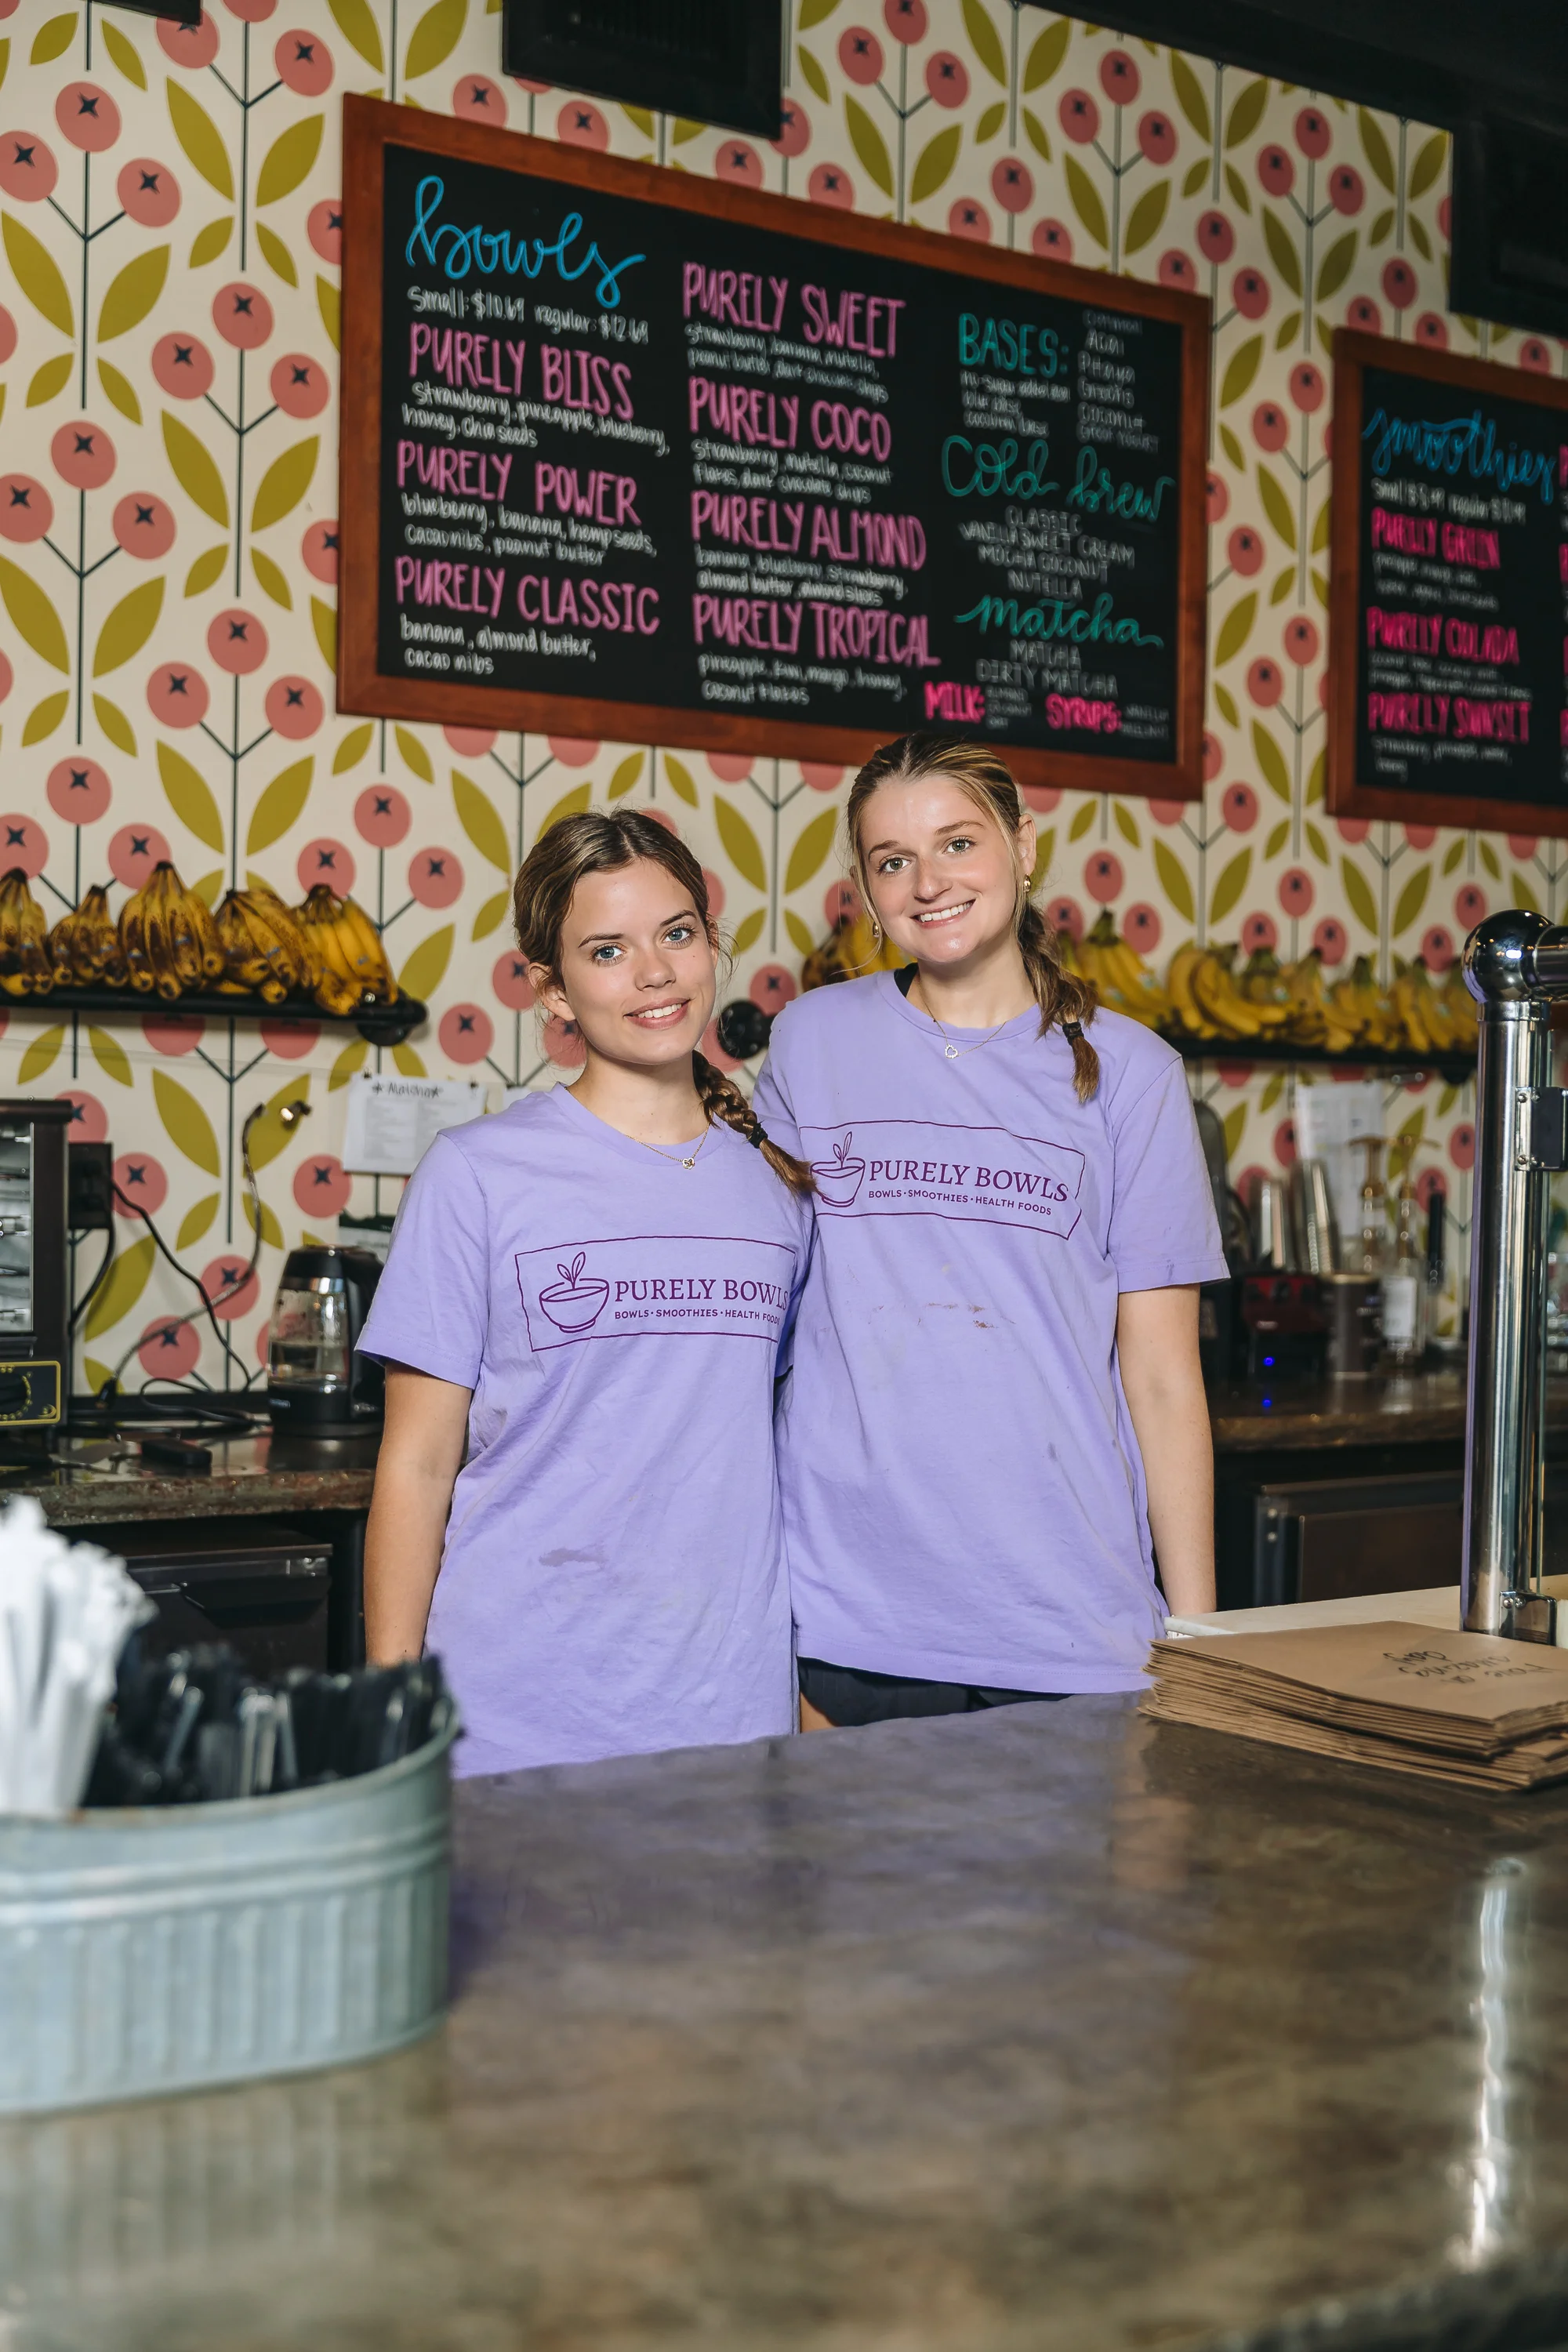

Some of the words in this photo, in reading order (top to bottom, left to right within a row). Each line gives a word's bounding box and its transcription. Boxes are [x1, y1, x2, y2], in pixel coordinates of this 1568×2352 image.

[406, 175, 646, 308] bowls
[683, 261, 788, 332] PURELY
[800, 284, 906, 358] SWEET
[409, 322, 525, 395] PURELY
[540, 343, 633, 420] BLISS
[959, 313, 1069, 378] BASES:
[689, 376, 799, 450] PURELY
[811, 400, 891, 462] COCO
[397, 439, 513, 502] PURELY
[535, 461, 641, 526] POWER
[942, 435, 1059, 499] Cold
[1065, 445, 1175, 521] brew
[691, 490, 804, 553] PURELY
[810, 505, 926, 571] ALMOND
[1005, 505, 1083, 536] CLASSIC
[1371, 506, 1438, 557] PURELY
[1077, 535, 1135, 570] CREAM
[395, 555, 505, 619] PURELY
[517, 575, 660, 635] CLASSIC
[1007, 569, 1083, 601] NUTELLA
[691, 593, 804, 655] PURELY
[808, 601, 941, 669] TROPICAL
[1010, 638, 1081, 673] MATCHA
[1367, 605, 1443, 657] PURELY
[1445, 618, 1520, 665] COLADA
[975, 659, 1038, 691] DIRTY
[1041, 667, 1118, 699] MATCHA
[1367, 691, 1450, 736] PURELY
[1453, 696, 1532, 743] SUNSET
[869, 1160, 970, 1186] PURELY
[975, 1167, 1069, 1202] BOWLS
[869, 1189, 902, 1199] BOWLS
[908, 1189, 968, 1203] SMOOTHIES
[975, 1196, 1014, 1208] HEALTH
[1018, 1202, 1051, 1215] FOODS
[614, 1309, 649, 1319] BOWLS
[655, 1308, 718, 1317] SMOOTHIES
[724, 1309, 760, 1320] HEALTH
[615, 1279, 717, 1302] PURELY
[723, 1280, 789, 1311] BOWLS
